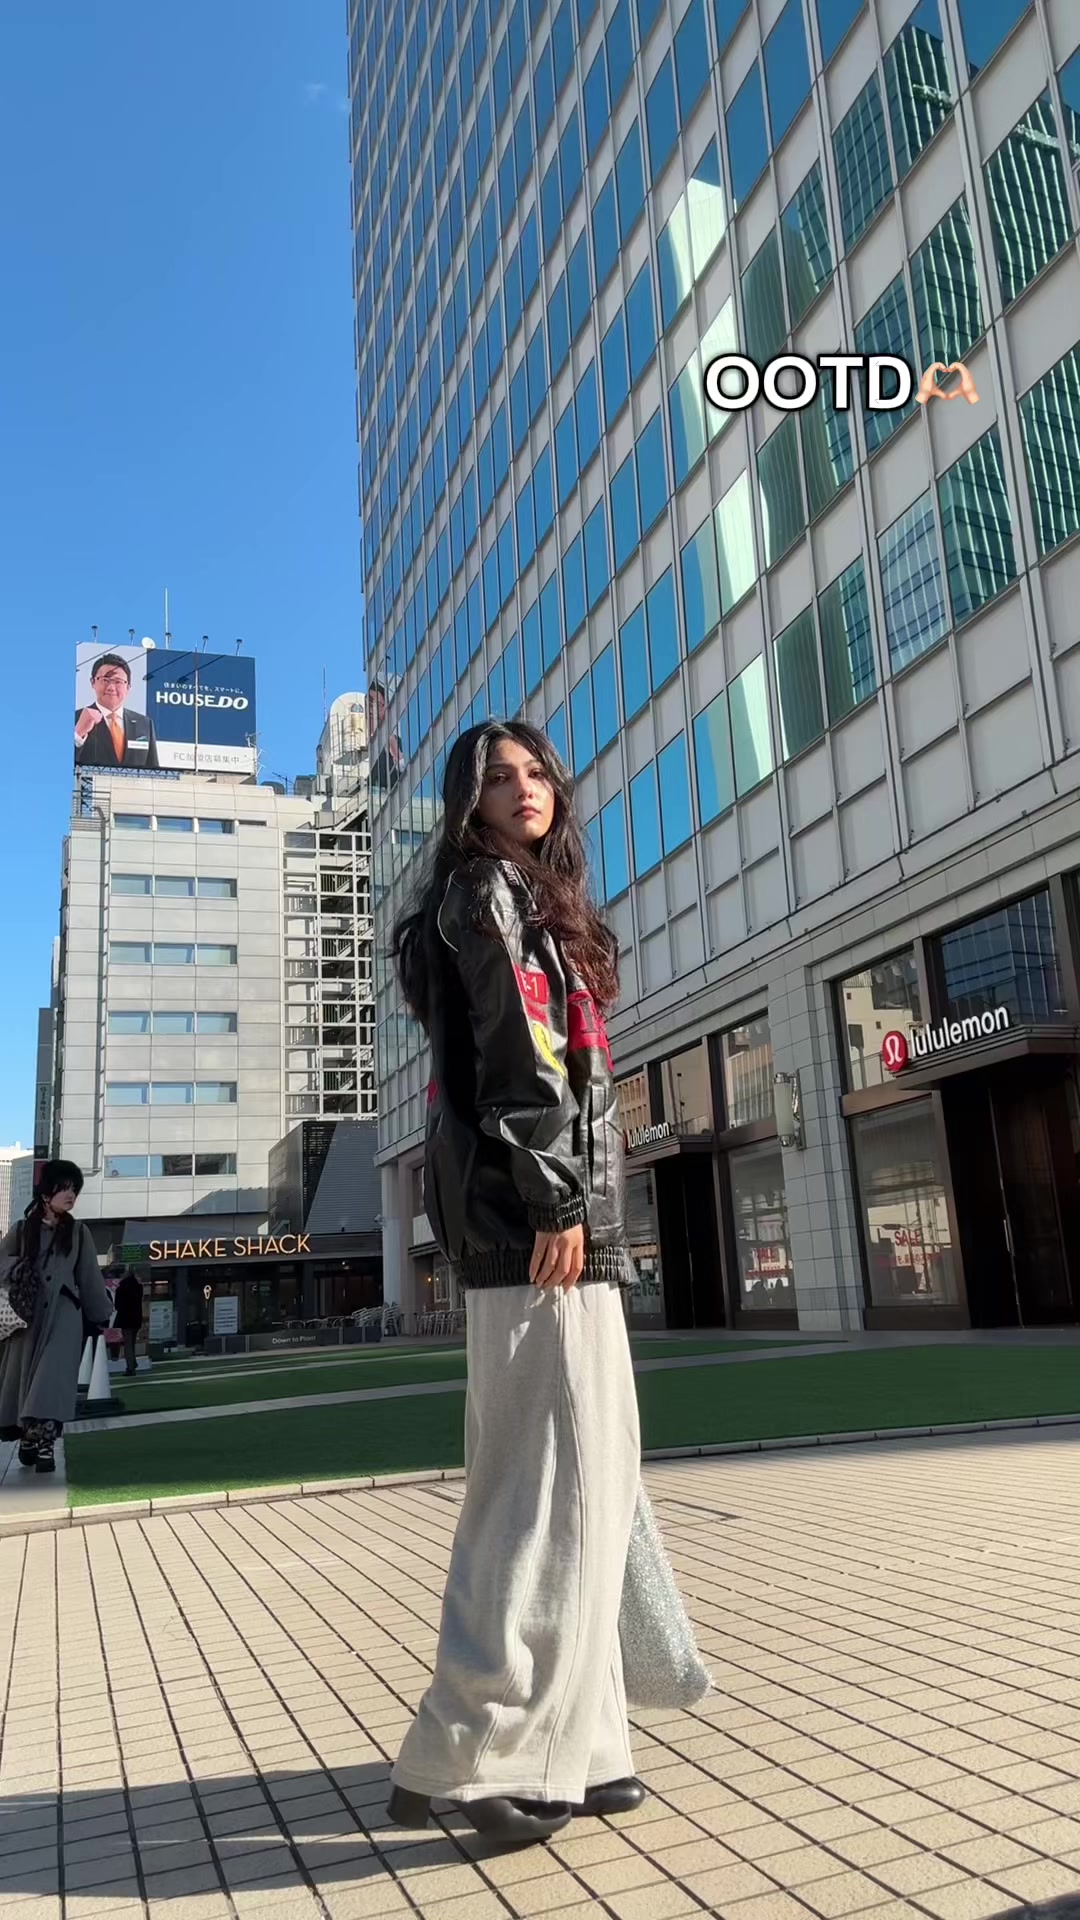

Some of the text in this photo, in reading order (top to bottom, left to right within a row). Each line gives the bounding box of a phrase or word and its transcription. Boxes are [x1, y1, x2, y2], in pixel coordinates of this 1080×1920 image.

[910, 1006, 1009, 1058] lululemon
[627, 1121, 670, 1149] lululemon
[149, 1237, 228, 1261] SHAKE
[233, 1233, 312, 1257] SHACK
